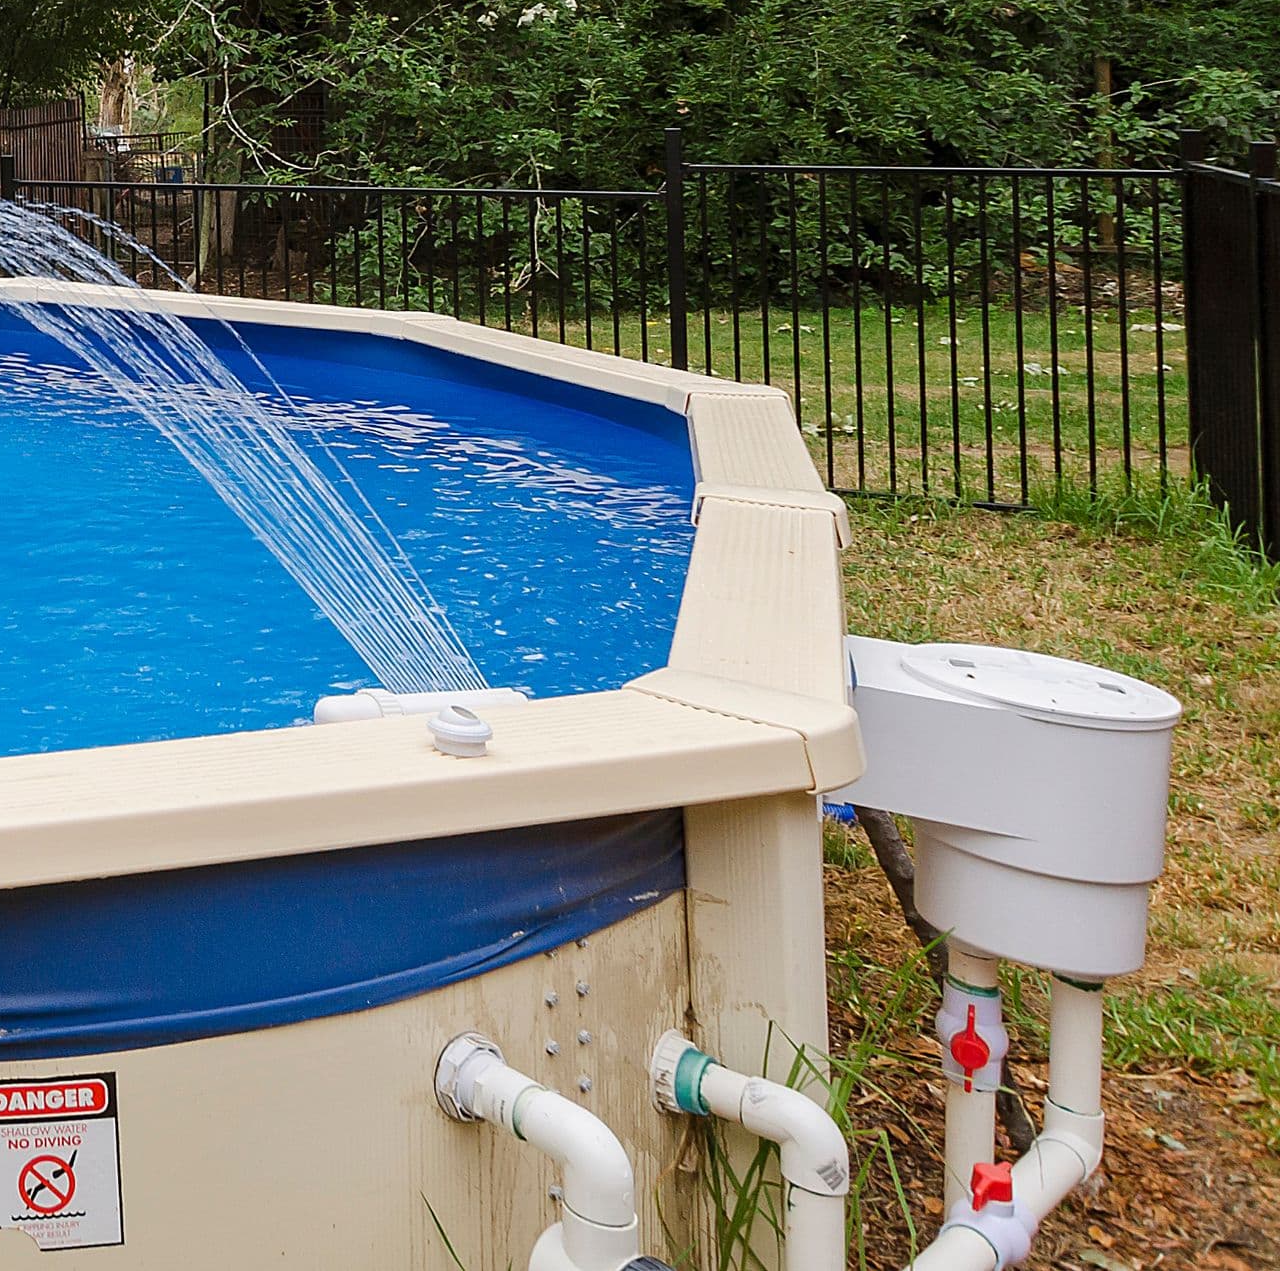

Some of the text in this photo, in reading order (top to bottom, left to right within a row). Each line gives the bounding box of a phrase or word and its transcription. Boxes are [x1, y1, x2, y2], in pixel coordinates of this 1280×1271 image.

[1, 1123, 88, 1138] SHALLOW WATER
[8, 1135, 82, 1149] NO DIVING
